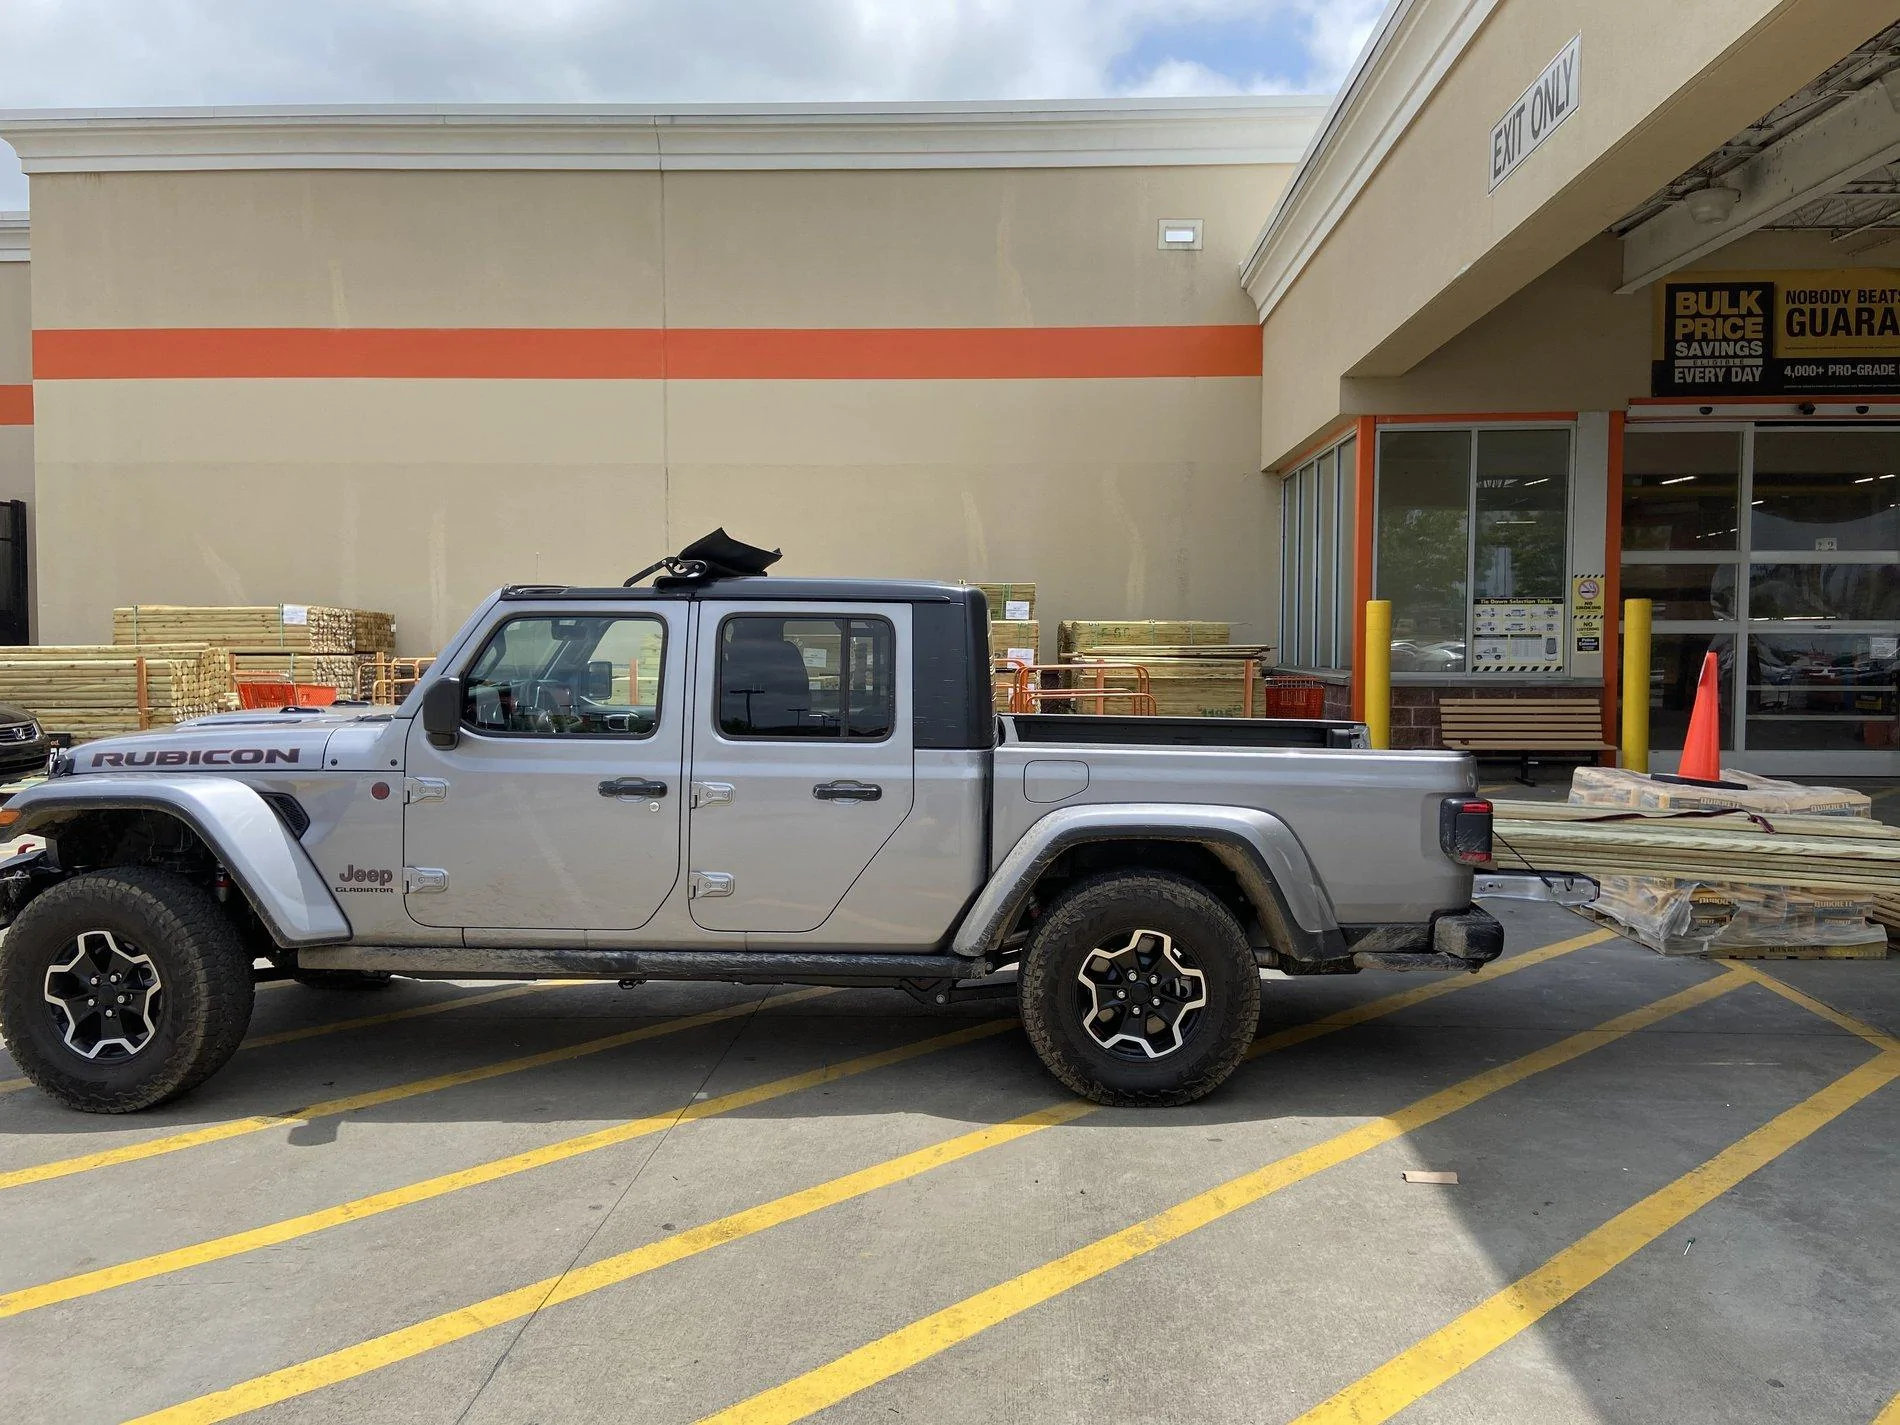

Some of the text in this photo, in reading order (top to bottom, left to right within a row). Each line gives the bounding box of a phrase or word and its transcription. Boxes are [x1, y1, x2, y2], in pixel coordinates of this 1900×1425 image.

[1493, 48, 1575, 180] EXIT ONLY
[1675, 290, 1762, 315] BULK
[1785, 289, 1900, 305] NOBODY BEAT
[1675, 317, 1763, 340] PRICE
[1786, 307, 1900, 337] GUARA
[1674, 341, 1763, 356] SAVINGS
[1674, 366, 1763, 383] EVERY DAY
[1784, 364, 1895, 379] 4,000+ PRO-GRADE
[91, 748, 301, 768] RUBICON
[339, 864, 393, 886] Jeep
